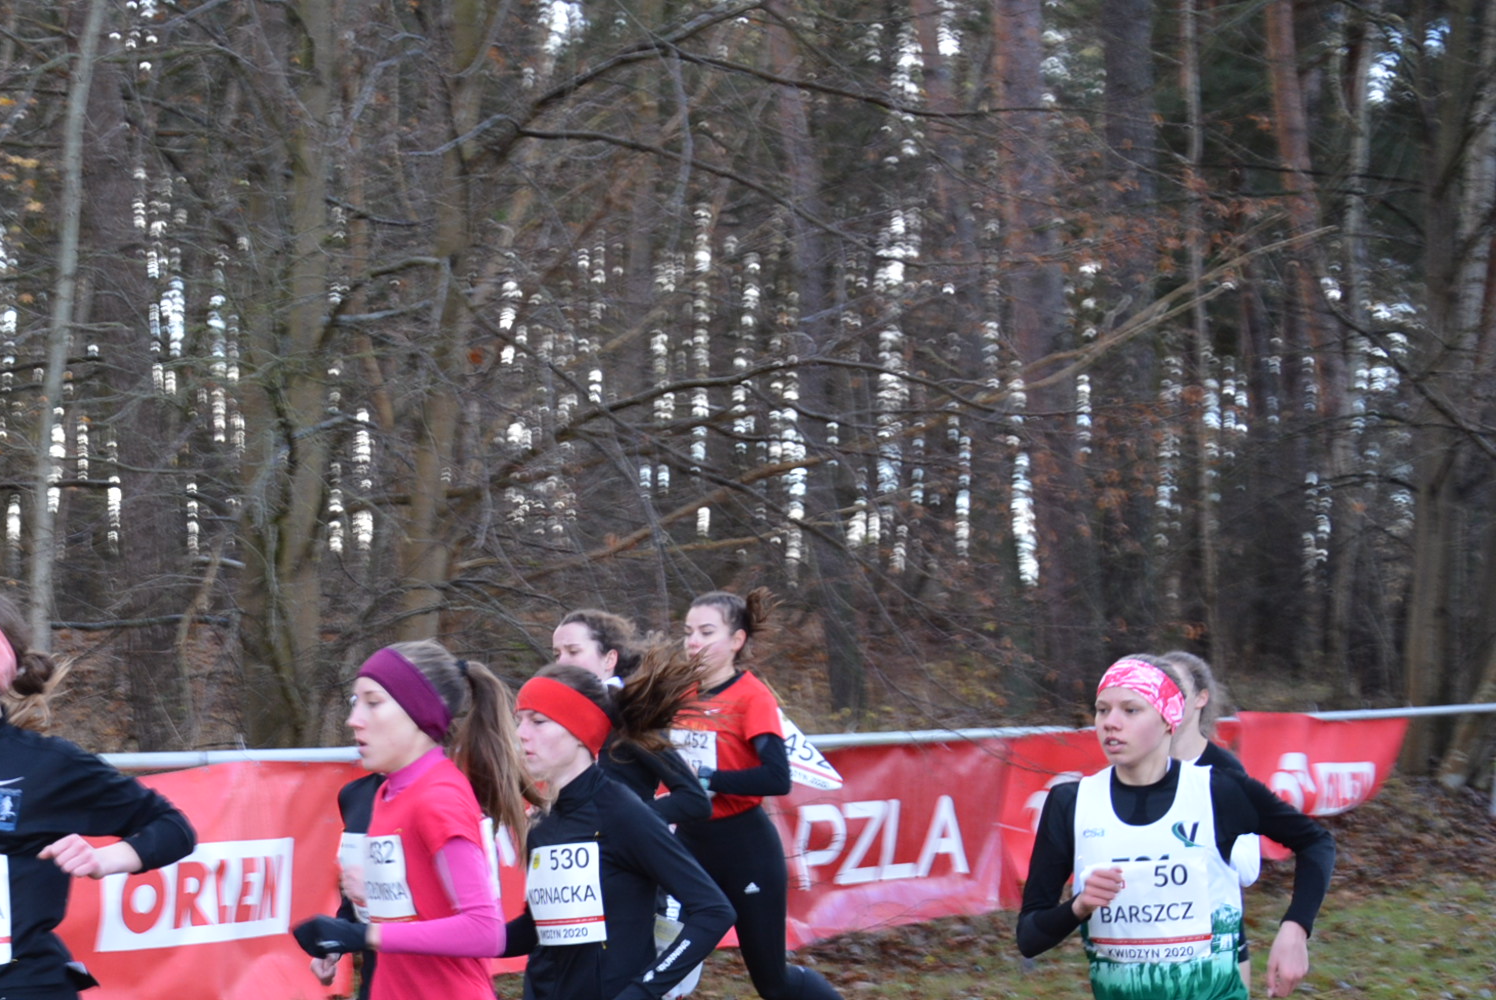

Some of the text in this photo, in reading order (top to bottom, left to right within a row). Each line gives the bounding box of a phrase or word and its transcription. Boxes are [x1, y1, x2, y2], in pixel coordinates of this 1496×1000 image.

[794, 794, 971, 892] PZLA
[550, 847, 590, 871] 530
[1154, 864, 1188, 888] 50
[121, 855, 284, 935] ORLEN
[529, 884, 597, 906] KORNACKA
[1100, 901, 1195, 924] BARSZCZ
[563, 927, 589, 939] 2020
[1107, 946, 1195, 960] KWIDZYN 2020
